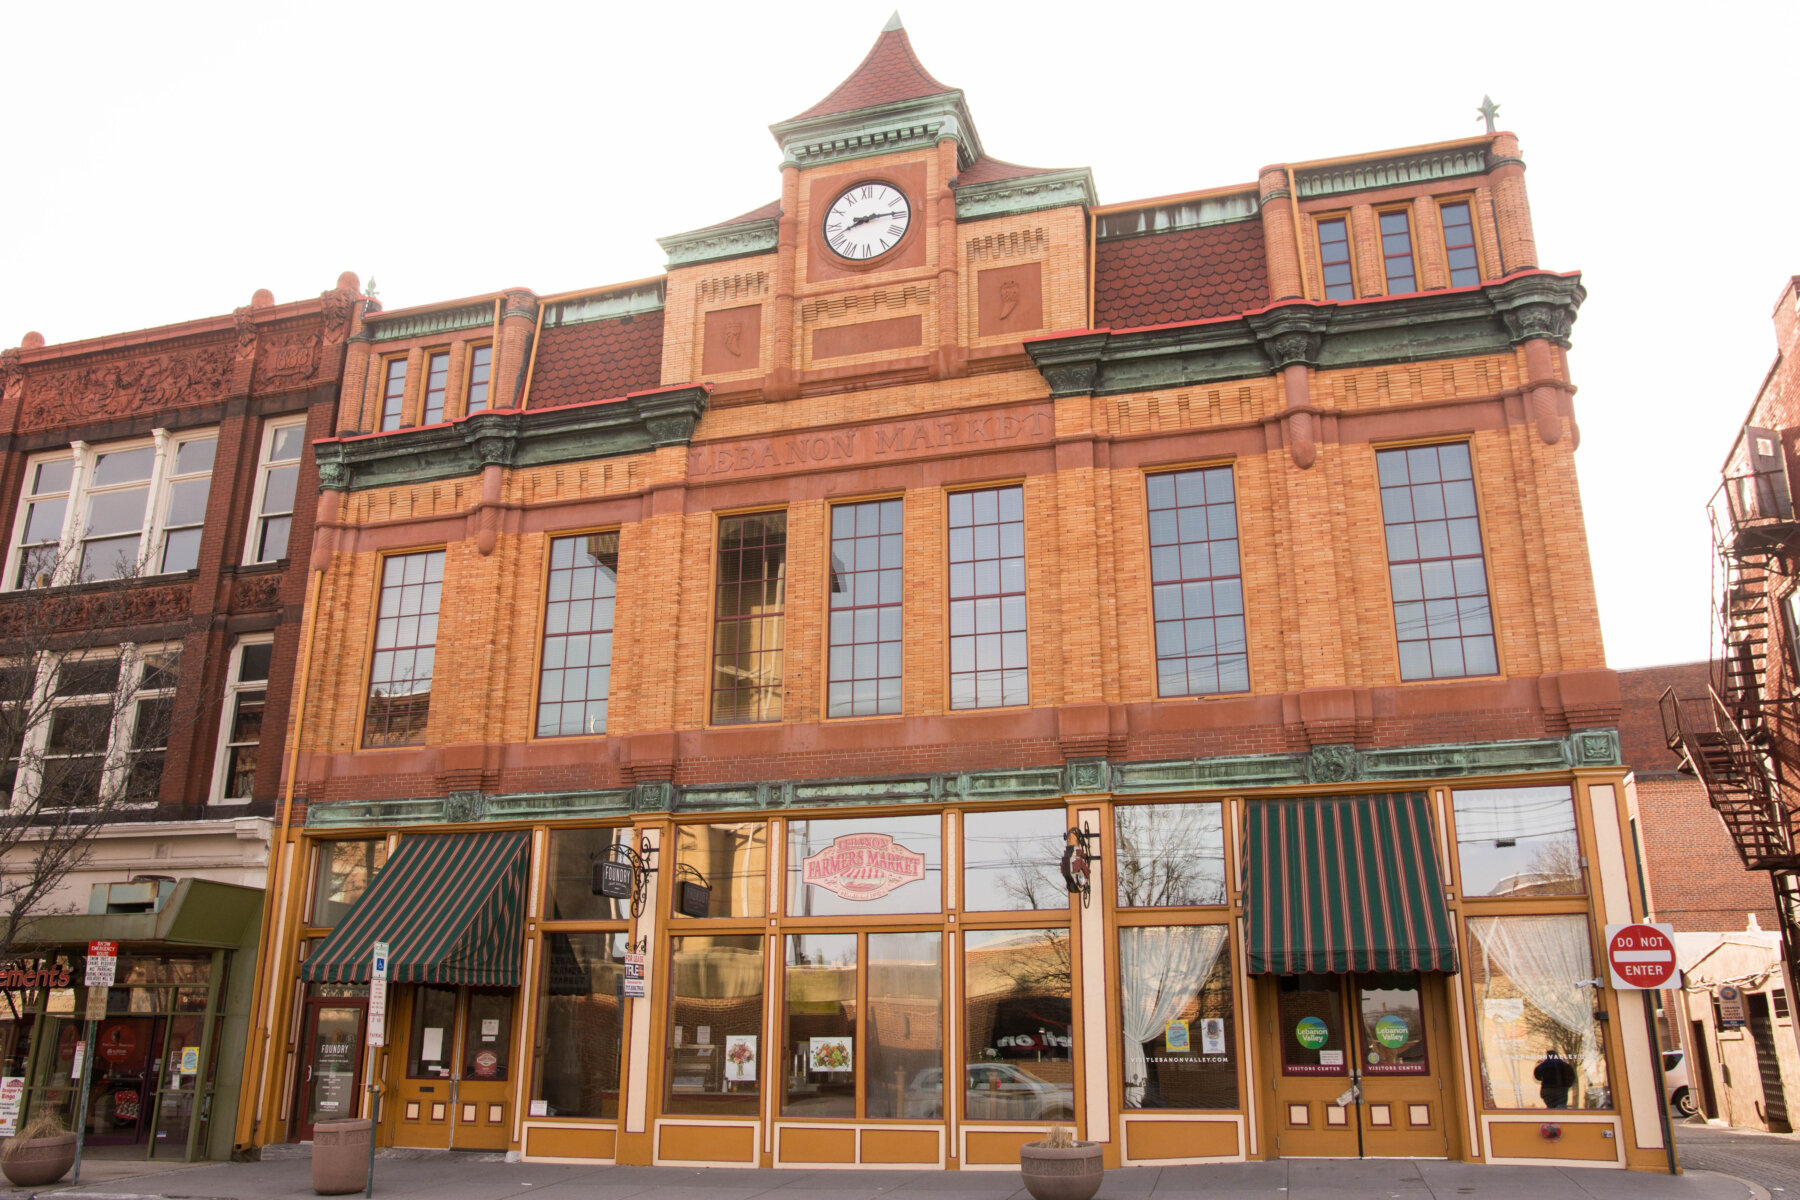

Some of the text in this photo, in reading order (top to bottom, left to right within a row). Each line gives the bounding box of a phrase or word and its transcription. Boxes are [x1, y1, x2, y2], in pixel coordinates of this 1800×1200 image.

[861, 186, 873, 200] XII
[844, 193, 858, 207] XI
[888, 196, 902, 208] II
[832, 208, 846, 216] X
[879, 238, 890, 250] V
[688, 411, 1052, 476] LEBANON MARKET
[837, 837, 889, 852] LEBANON
[807, 850, 921, 879] FARMERS MARKET
[605, 865, 631, 884] FOUNDRY
[1617, 936, 1664, 948] DO NOT
[1625, 965, 1664, 976] ENTER
[1382, 1034, 1404, 1042] Valley
[321, 1044, 349, 1054] FOUNDRY
